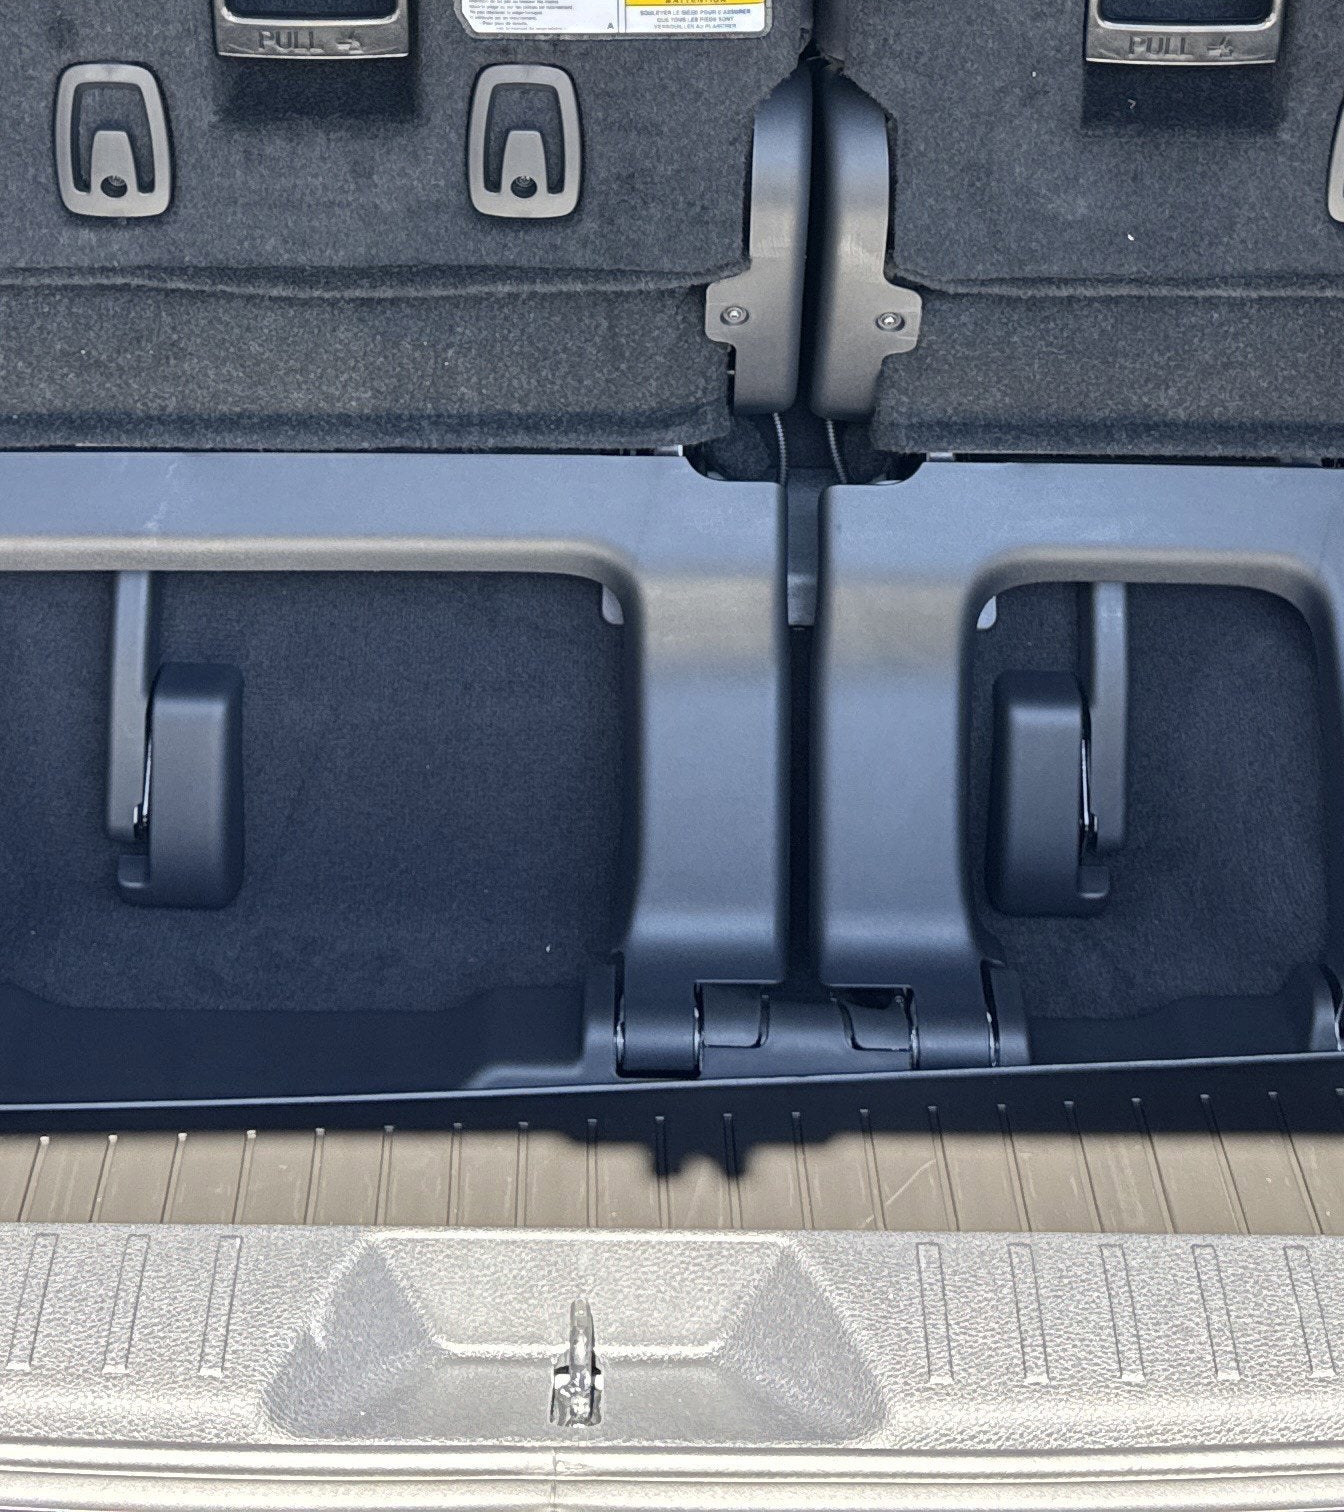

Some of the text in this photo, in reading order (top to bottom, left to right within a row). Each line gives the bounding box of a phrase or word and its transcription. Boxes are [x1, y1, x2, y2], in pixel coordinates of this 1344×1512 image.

[606, 22, 614, 30] A
[258, 29, 324, 53] PULL
[1128, 35, 1194, 59] PULL
